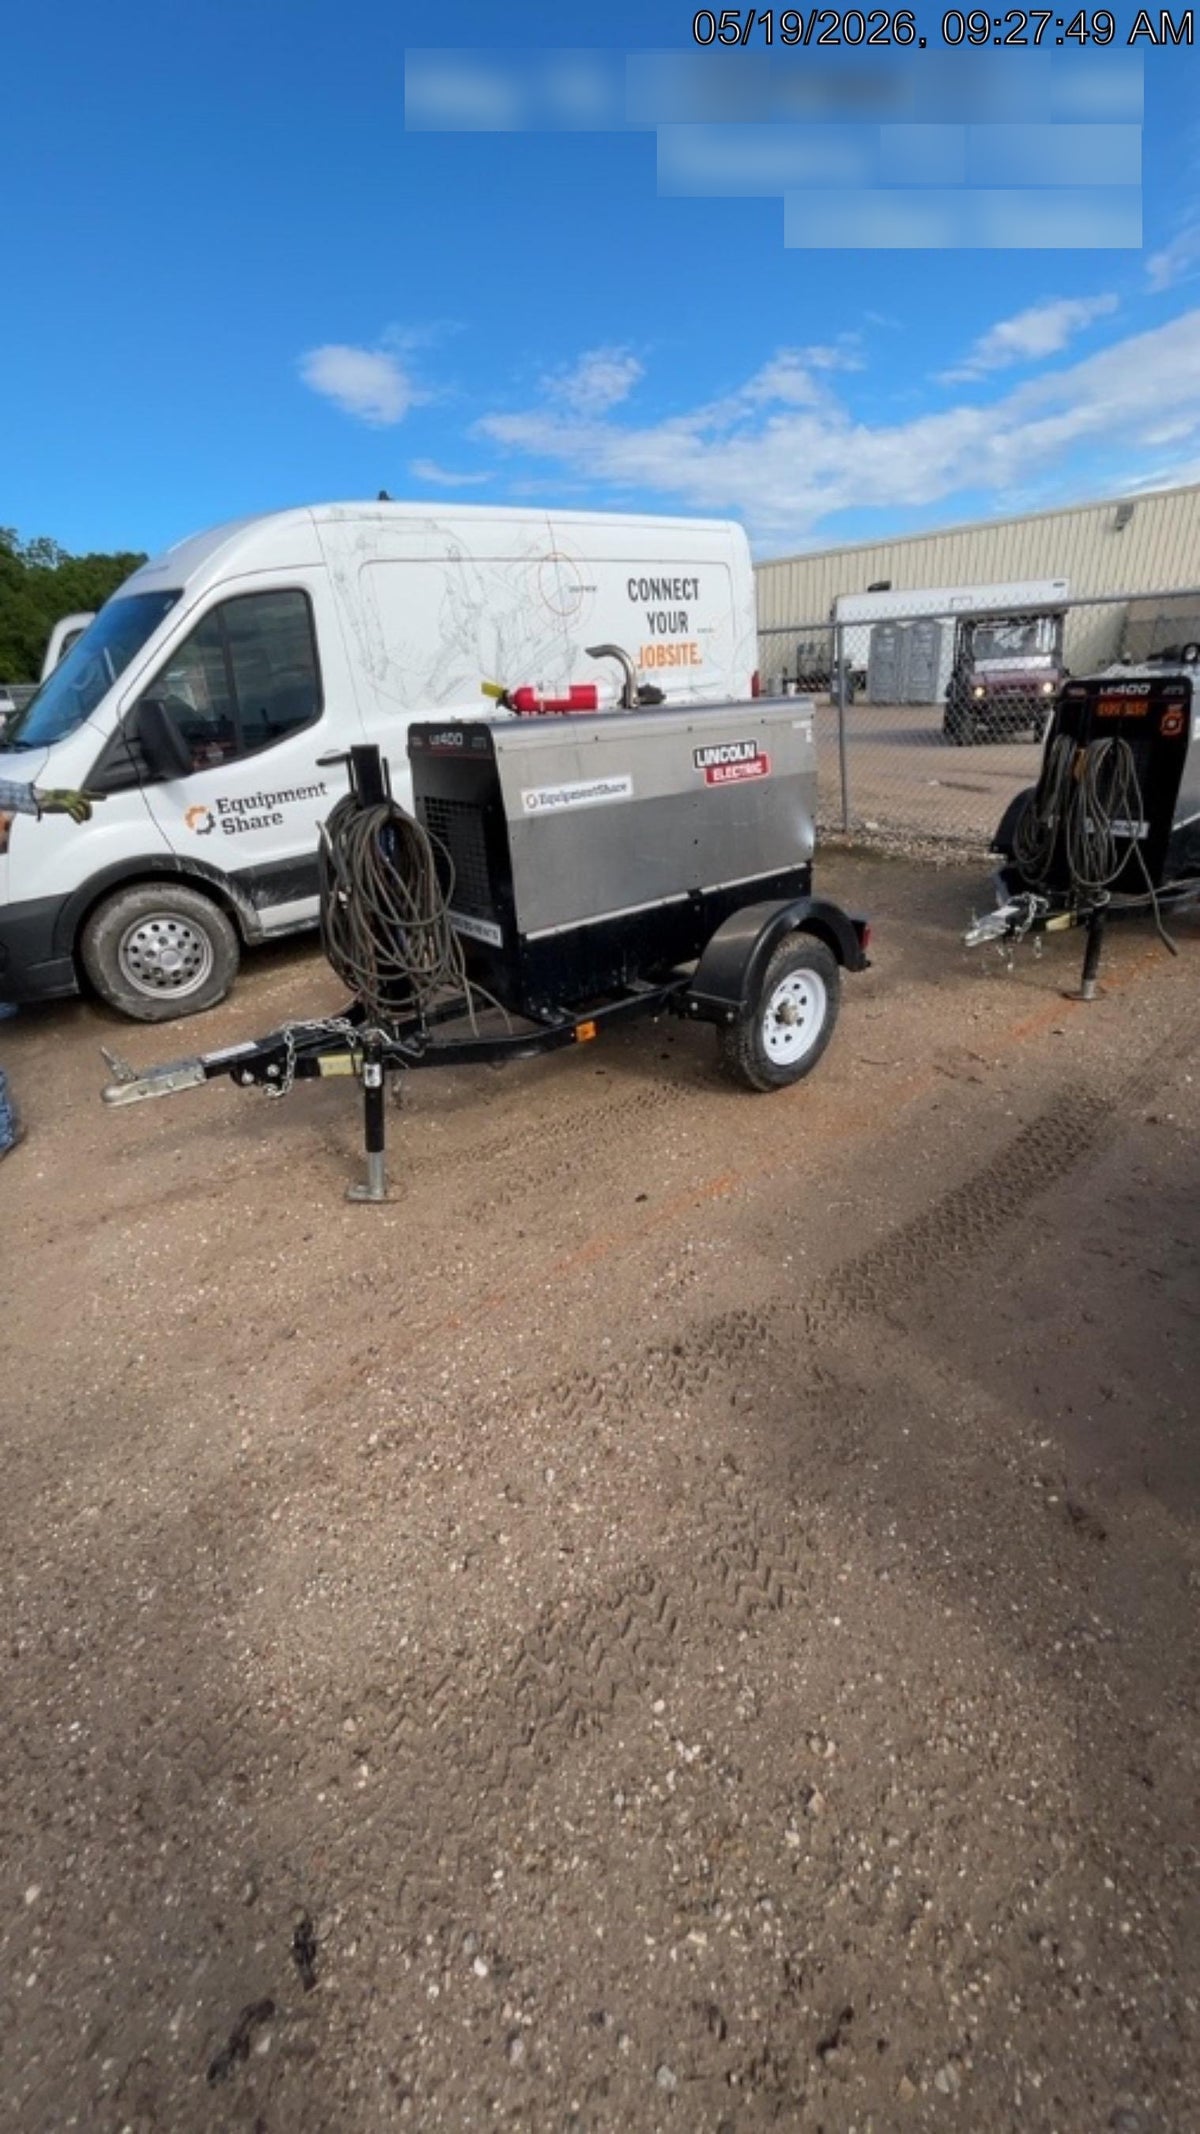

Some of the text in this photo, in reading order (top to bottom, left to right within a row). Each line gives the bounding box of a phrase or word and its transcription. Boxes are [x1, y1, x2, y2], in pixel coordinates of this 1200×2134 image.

[627, 577, 699, 602] CONNECT
[646, 611, 689, 634] YOUR
[638, 642, 703, 669] JOBSITE.
[697, 743, 756, 767] LINCOLN
[712, 760, 763, 781] ELECTRIC
[215, 781, 328, 815] Equipment
[221, 811, 284, 835] Share
